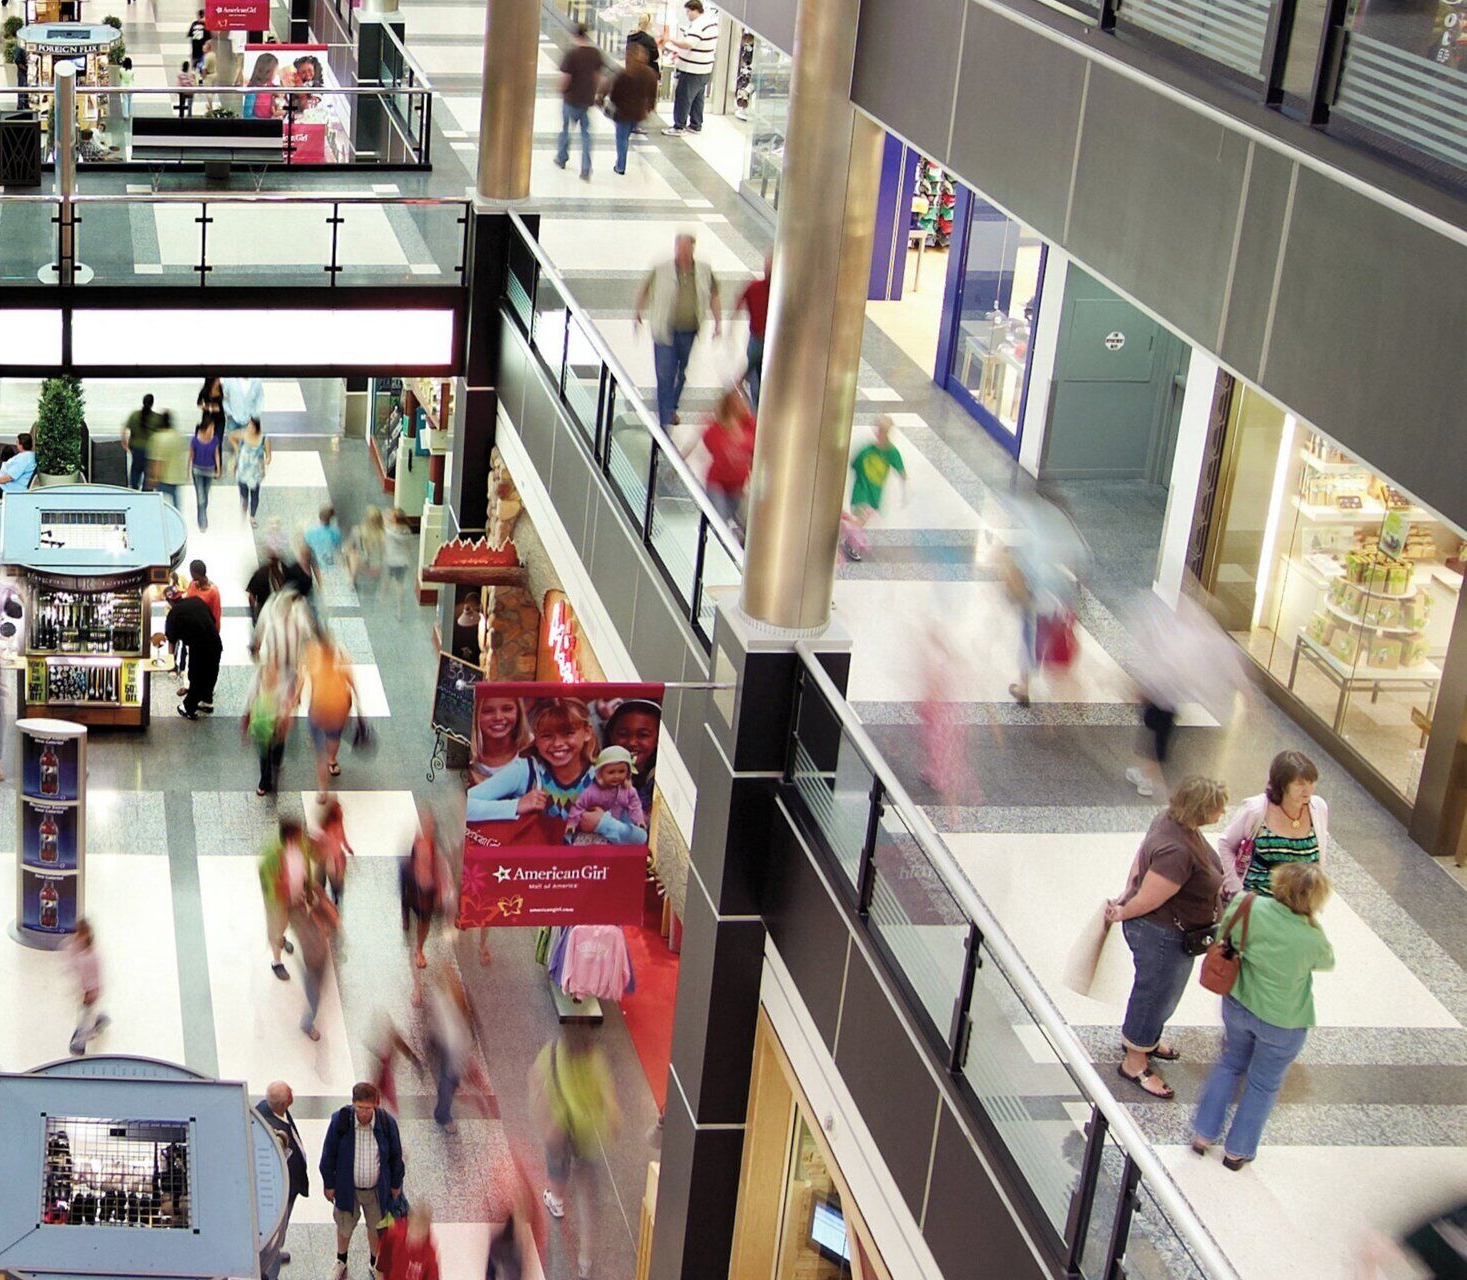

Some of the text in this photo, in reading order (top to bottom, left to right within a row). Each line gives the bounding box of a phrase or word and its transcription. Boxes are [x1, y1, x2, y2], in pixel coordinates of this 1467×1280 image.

[38, 44, 98, 53] FOREIGN FLIX
[513, 865, 607, 881] American Girl
